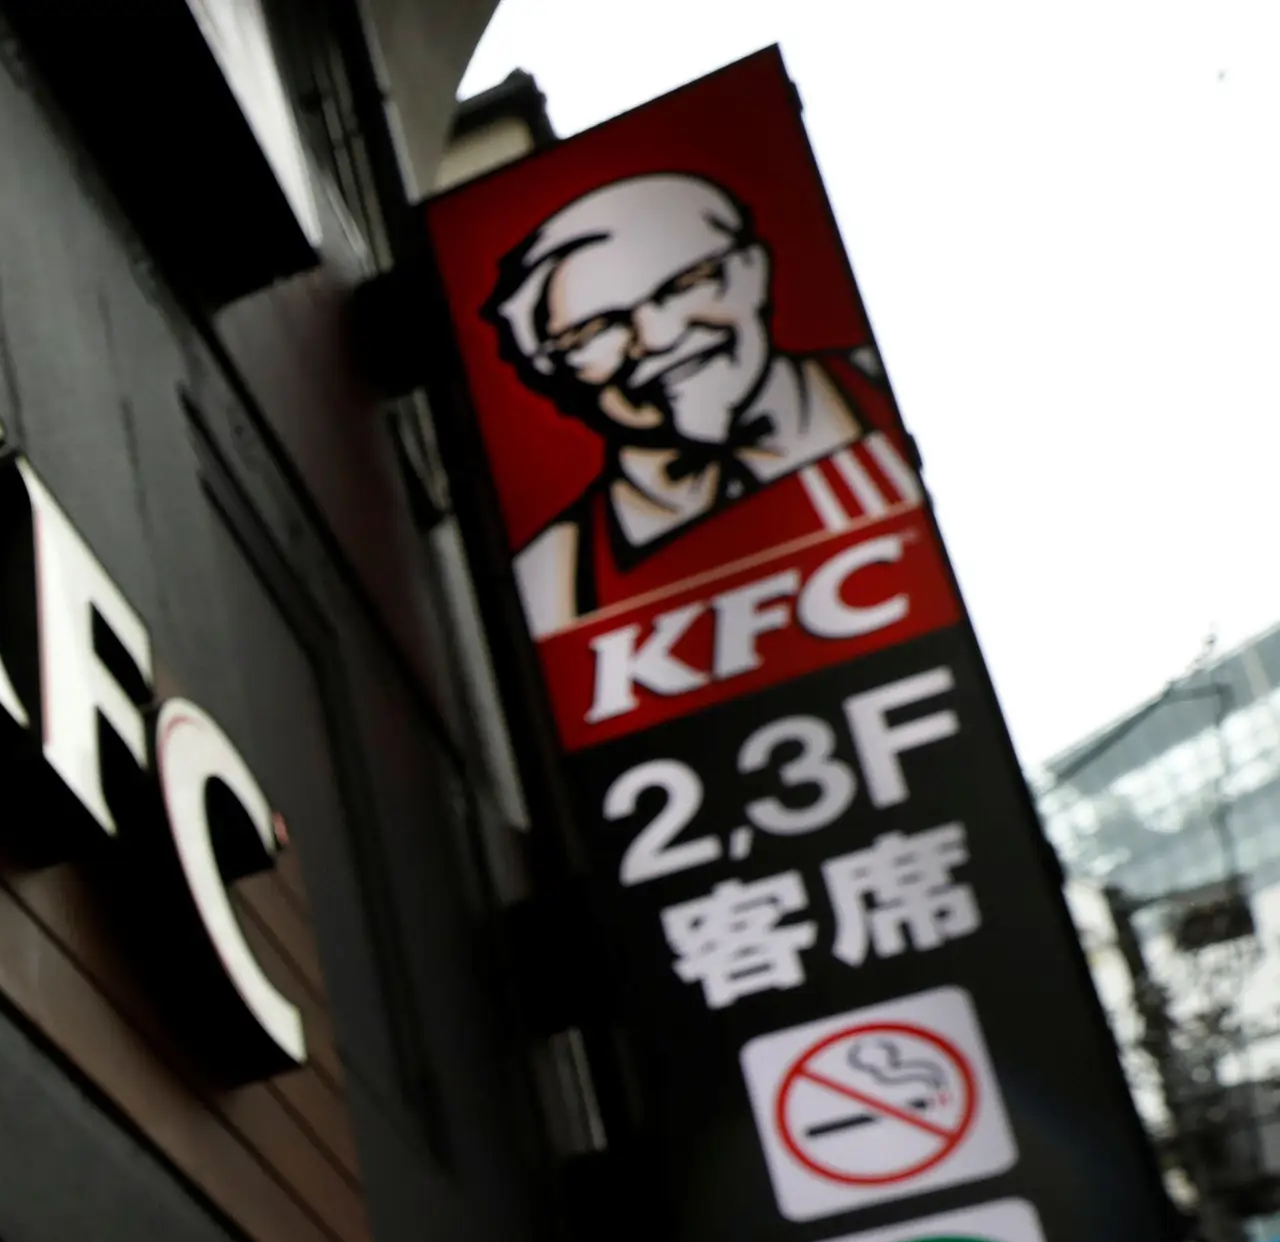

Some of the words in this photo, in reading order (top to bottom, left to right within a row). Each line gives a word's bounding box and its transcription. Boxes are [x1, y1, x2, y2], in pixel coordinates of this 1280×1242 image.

[584, 532, 910, 724] KFC
[601, 666, 960, 887] 2,3F
[660, 822, 982, 1010] 客席
